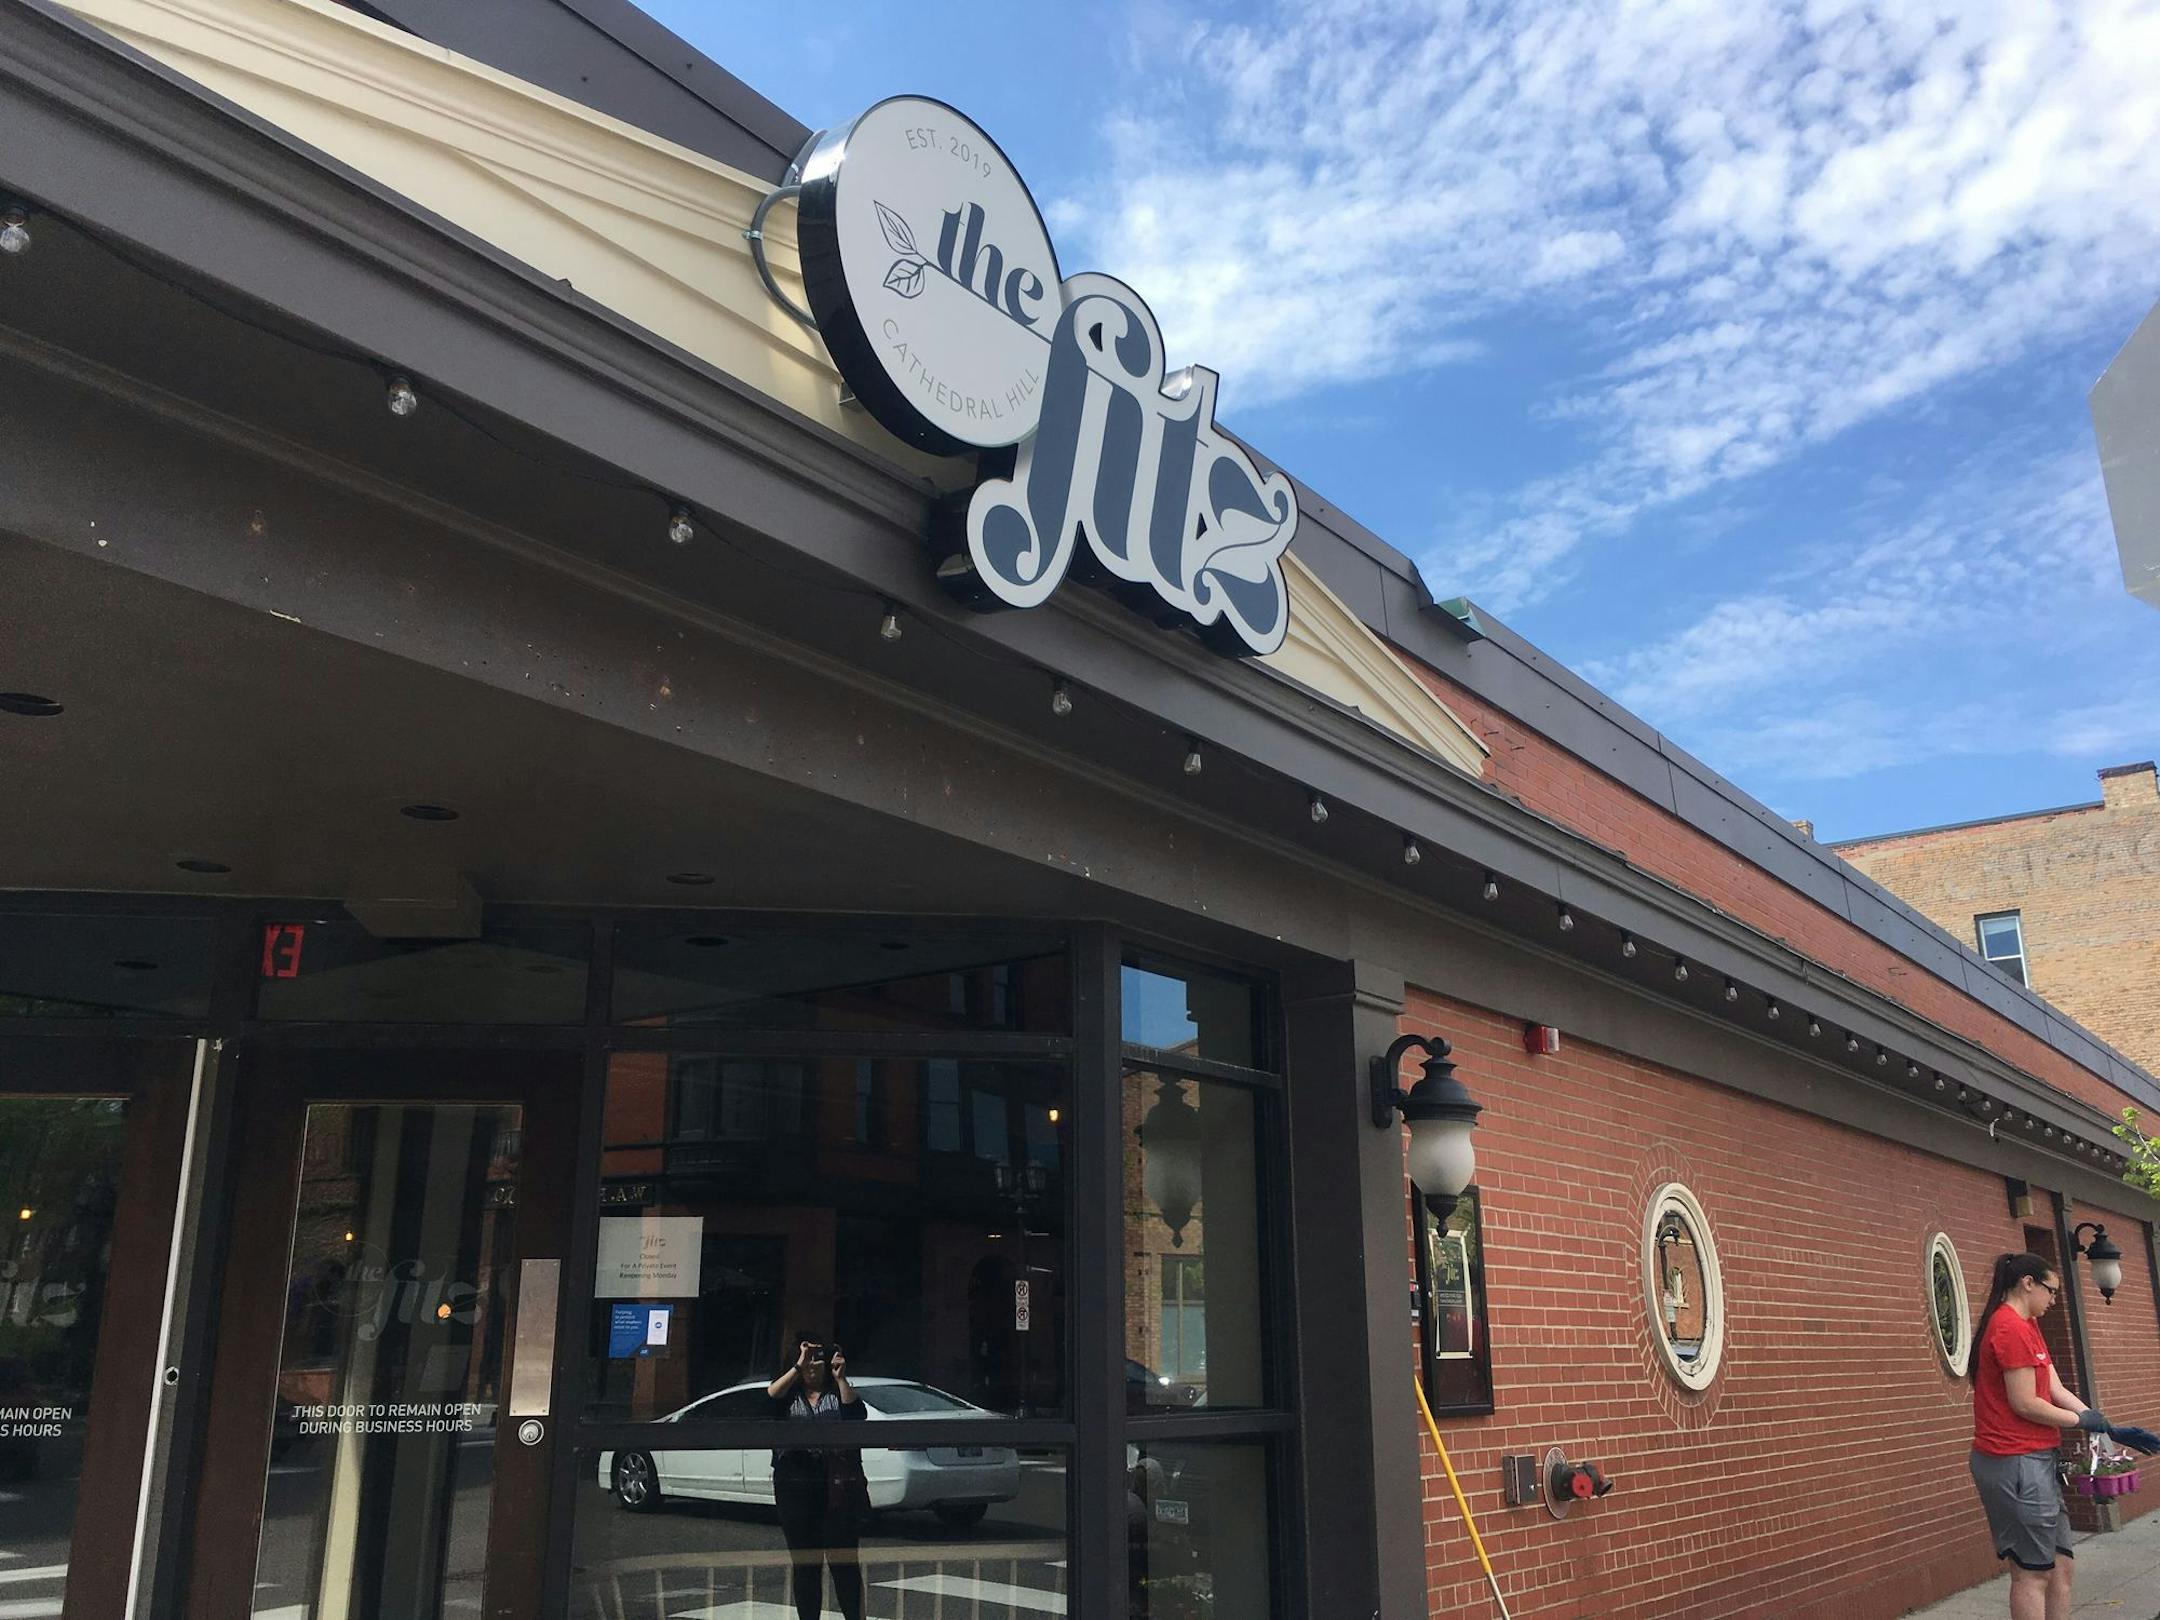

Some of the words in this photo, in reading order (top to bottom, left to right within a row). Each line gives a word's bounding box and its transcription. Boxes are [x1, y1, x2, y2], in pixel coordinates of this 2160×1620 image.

[905, 127, 943, 151] EST.
[949, 136, 992, 179] 2019
[936, 201, 1045, 327] the
[883, 318, 1004, 421] CATHEDRAL
[1007, 367, 1041, 413] HILL
[983, 294, 1288, 635] fitz
[32, 1407, 73, 1420] OPEN
[293, 1405, 325, 1418] THIS
[327, 1404, 365, 1418] DOOR
[368, 1404, 386, 1417] TO
[388, 1403, 442, 1417] REMAIN
[444, 1403, 482, 1416] OPEN
[299, 1421, 353, 1434] DURING
[355, 1420, 423, 1433] BUSINESS
[425, 1419, 473, 1432] HOURS
[12, 1423, 62, 1437] HOURS
